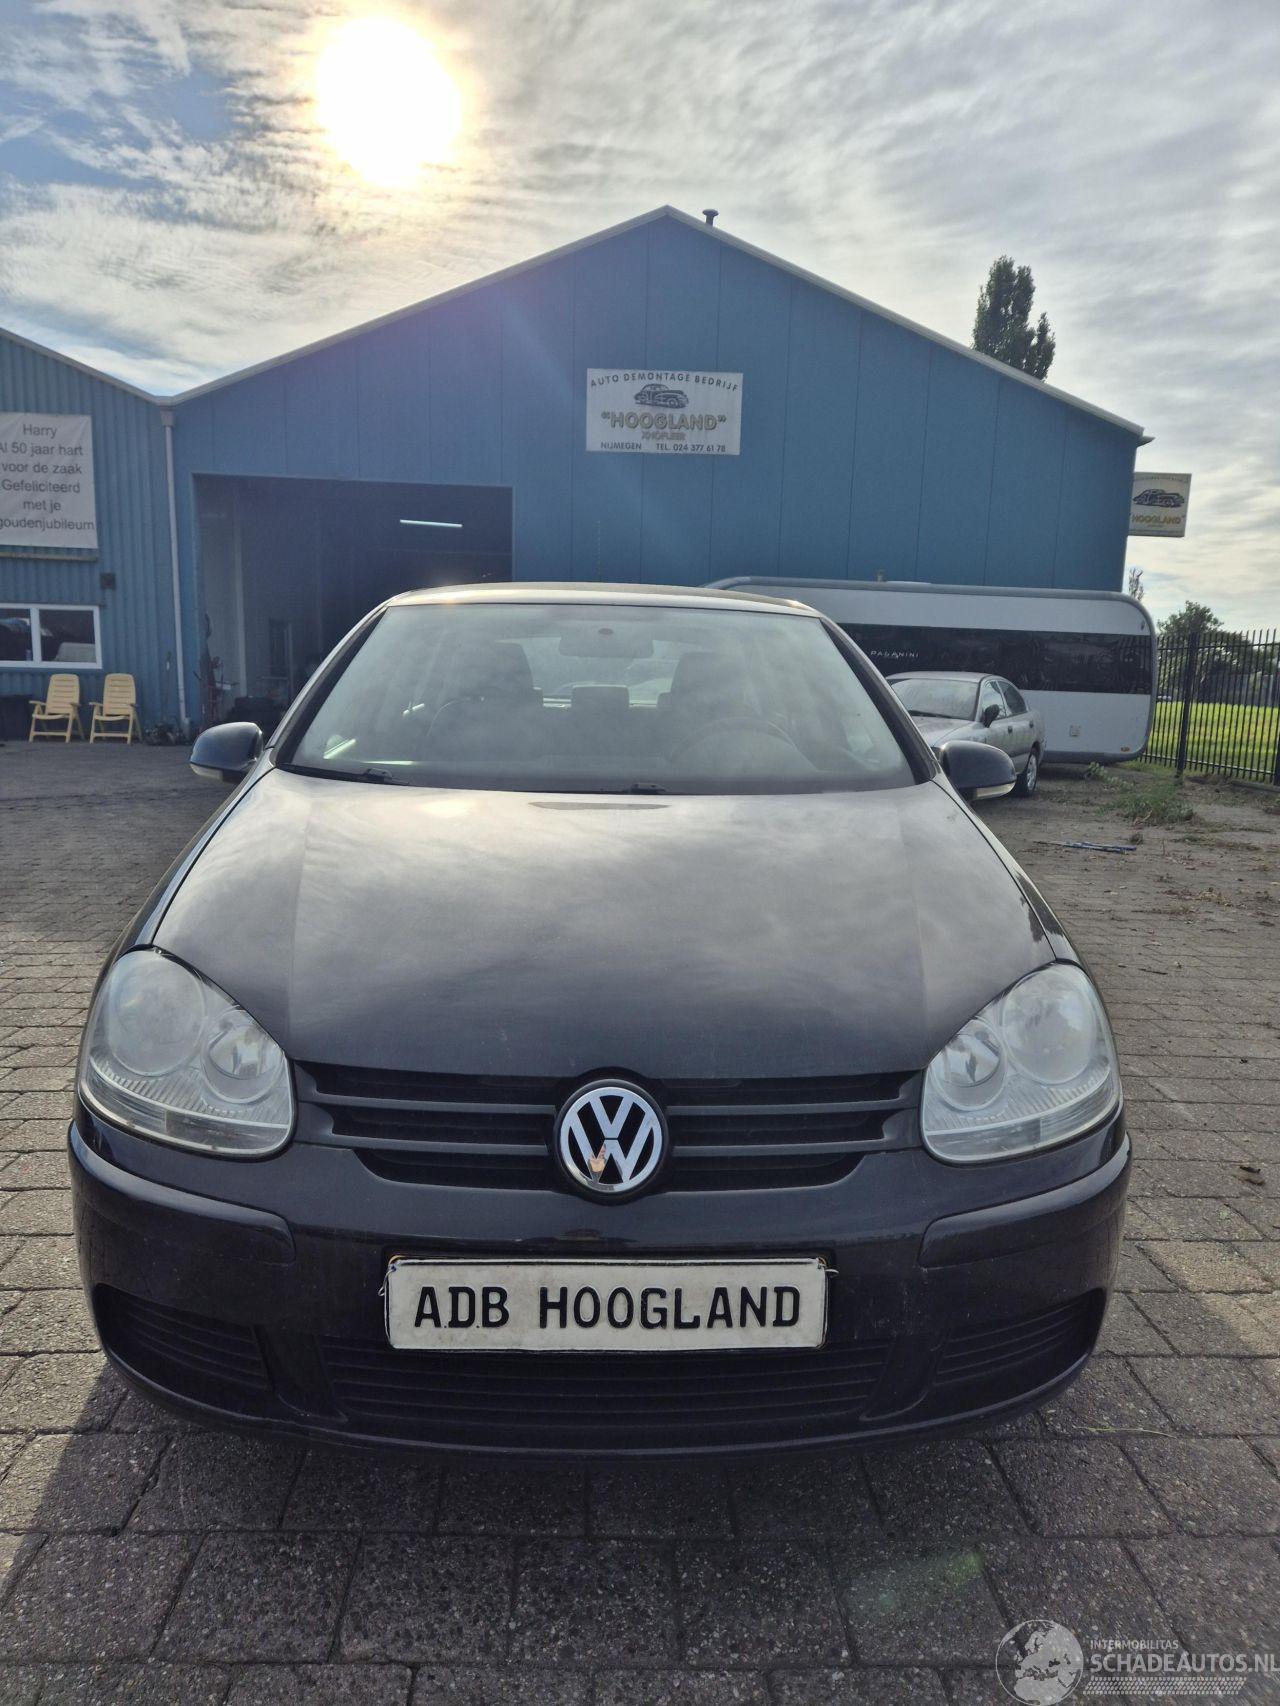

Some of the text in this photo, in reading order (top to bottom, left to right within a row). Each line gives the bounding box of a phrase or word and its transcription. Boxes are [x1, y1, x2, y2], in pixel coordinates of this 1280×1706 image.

[590, 372, 738, 392] AUTO DEMONTAGE BEDRIJF
[22, 424, 58, 438] Harry
[11, 441, 28, 454] 50
[30, 443, 55, 457] jaar
[58, 444, 83, 456] hart
[673, 443, 689, 452] 024
[691, 443, 704, 453] 377
[706, 444, 715, 453] 61
[716, 444, 726, 453] 78
[1, 462, 83, 475] voor de zaak
[1, 478, 81, 494] Gefeliciteerd
[23, 500, 62, 514] met je
[539, 1285, 800, 1330] HOOGLAND
